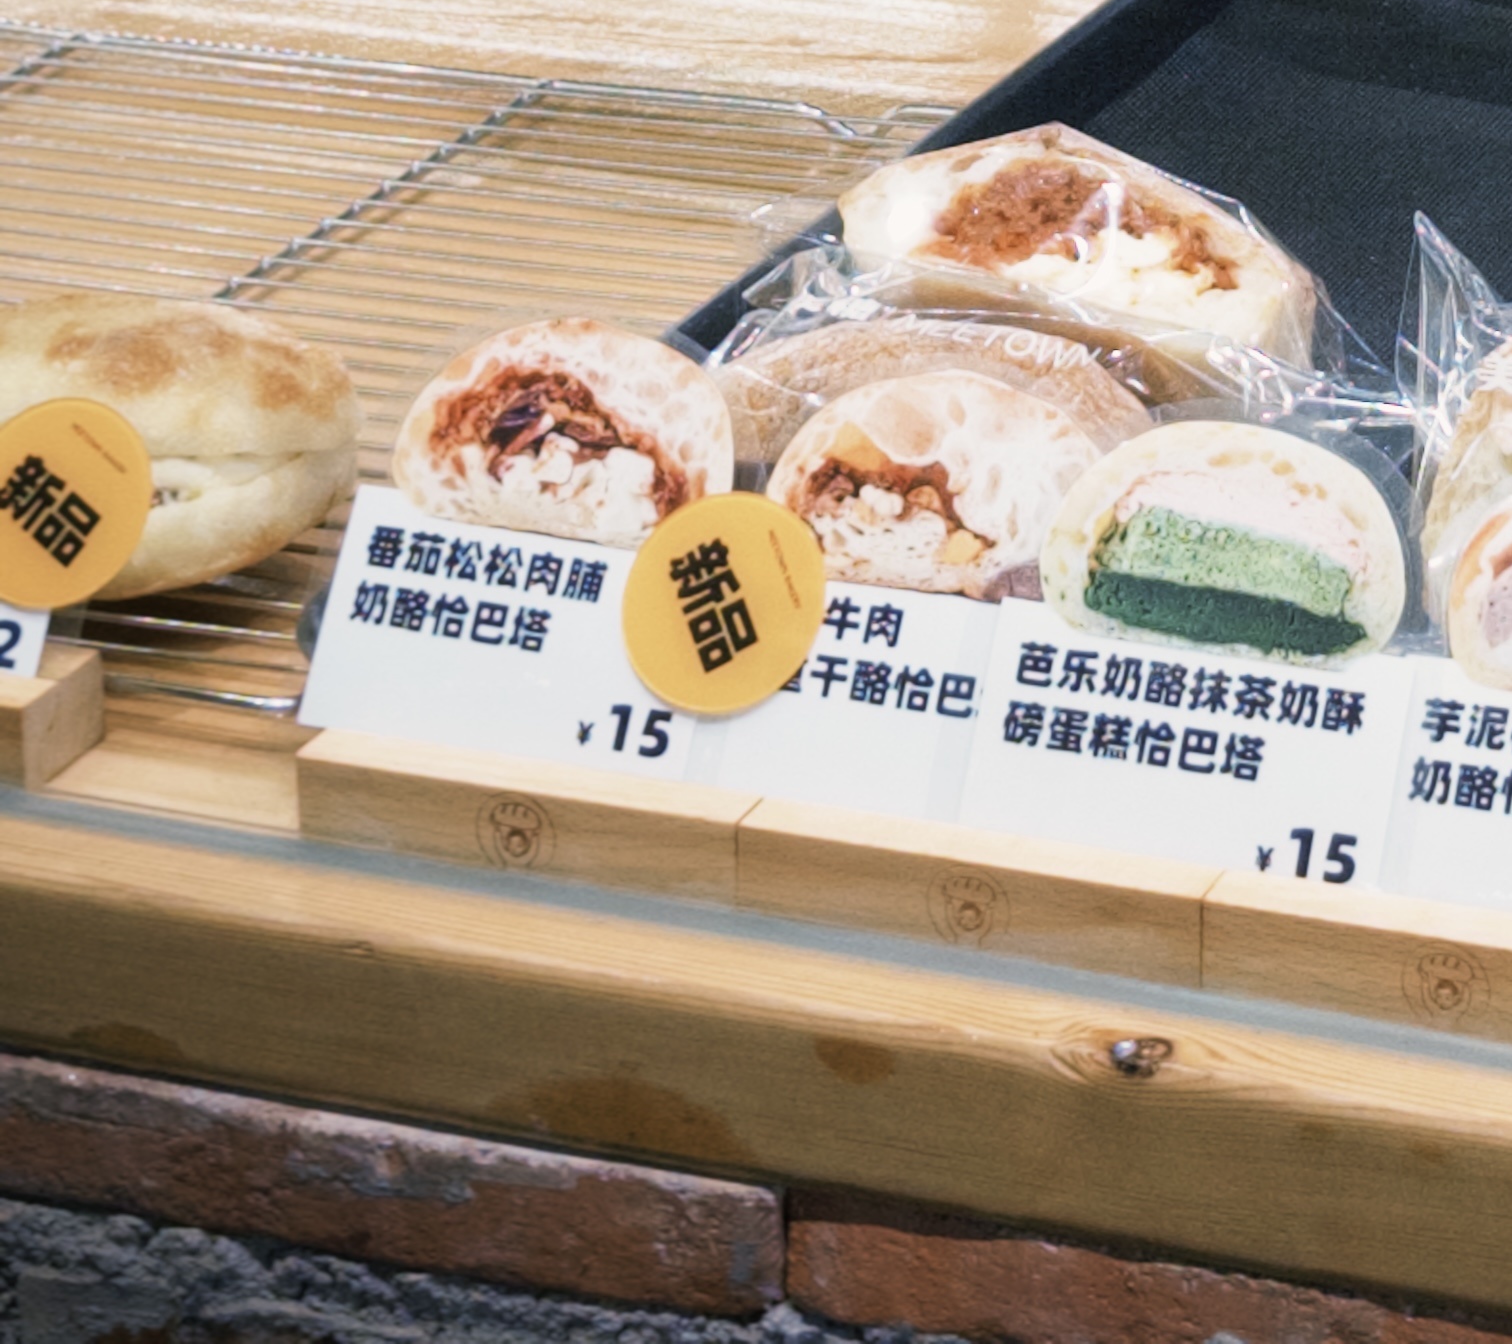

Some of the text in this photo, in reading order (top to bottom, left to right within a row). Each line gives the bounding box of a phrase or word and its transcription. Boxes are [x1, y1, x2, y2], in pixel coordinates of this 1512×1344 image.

[367, 524, 608, 604] 番茄松松肉脯
[350, 580, 552, 654] 奶酪恰巴塔
[669, 538, 760, 674] 新品
[780, 654, 980, 719] 干酪恰巴
[1015, 640, 1367, 737] 芭乐奶酪抹茶奶酥
[1002, 699, 1267, 783] 磅蛋糕恰巴塔
